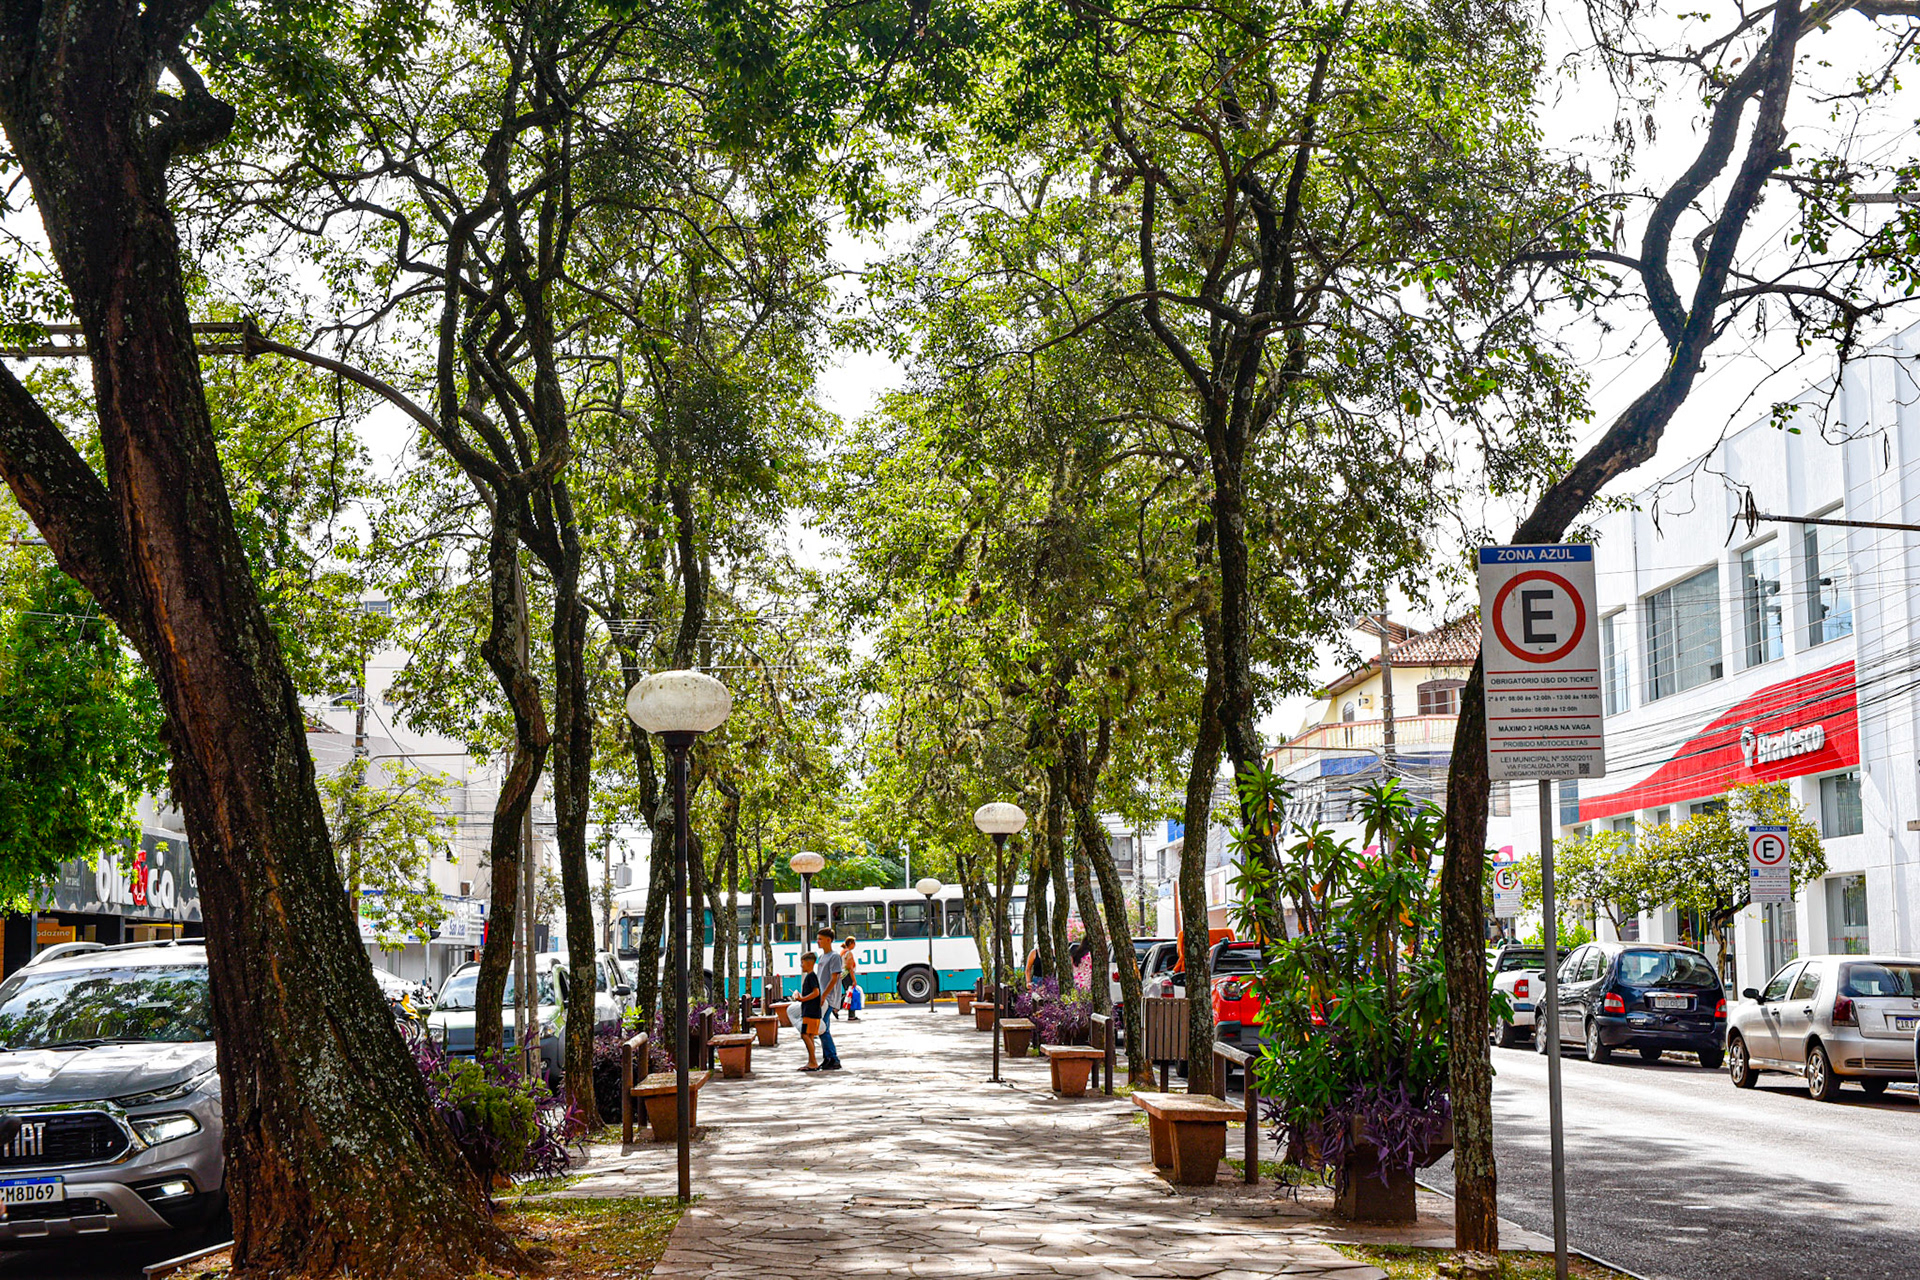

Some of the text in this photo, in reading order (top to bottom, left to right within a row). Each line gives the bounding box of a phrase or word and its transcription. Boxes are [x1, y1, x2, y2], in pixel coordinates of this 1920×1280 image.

[1497, 548, 1574, 561] ZONA AZUL
[1521, 589, 1557, 644] E
[1490, 677, 1540, 685] OBRIGATÓRIO
[1498, 724, 1527, 732] MÁXIMO
[1536, 739, 1589, 747] MOTOCICLETAS
[1757, 724, 1825, 764] Bradesco
[1503, 769, 1575, 777] VIDEOMONITORAMENTO
[1762, 841, 1775, 859] E
[3, 1122, 46, 1157] IAT
